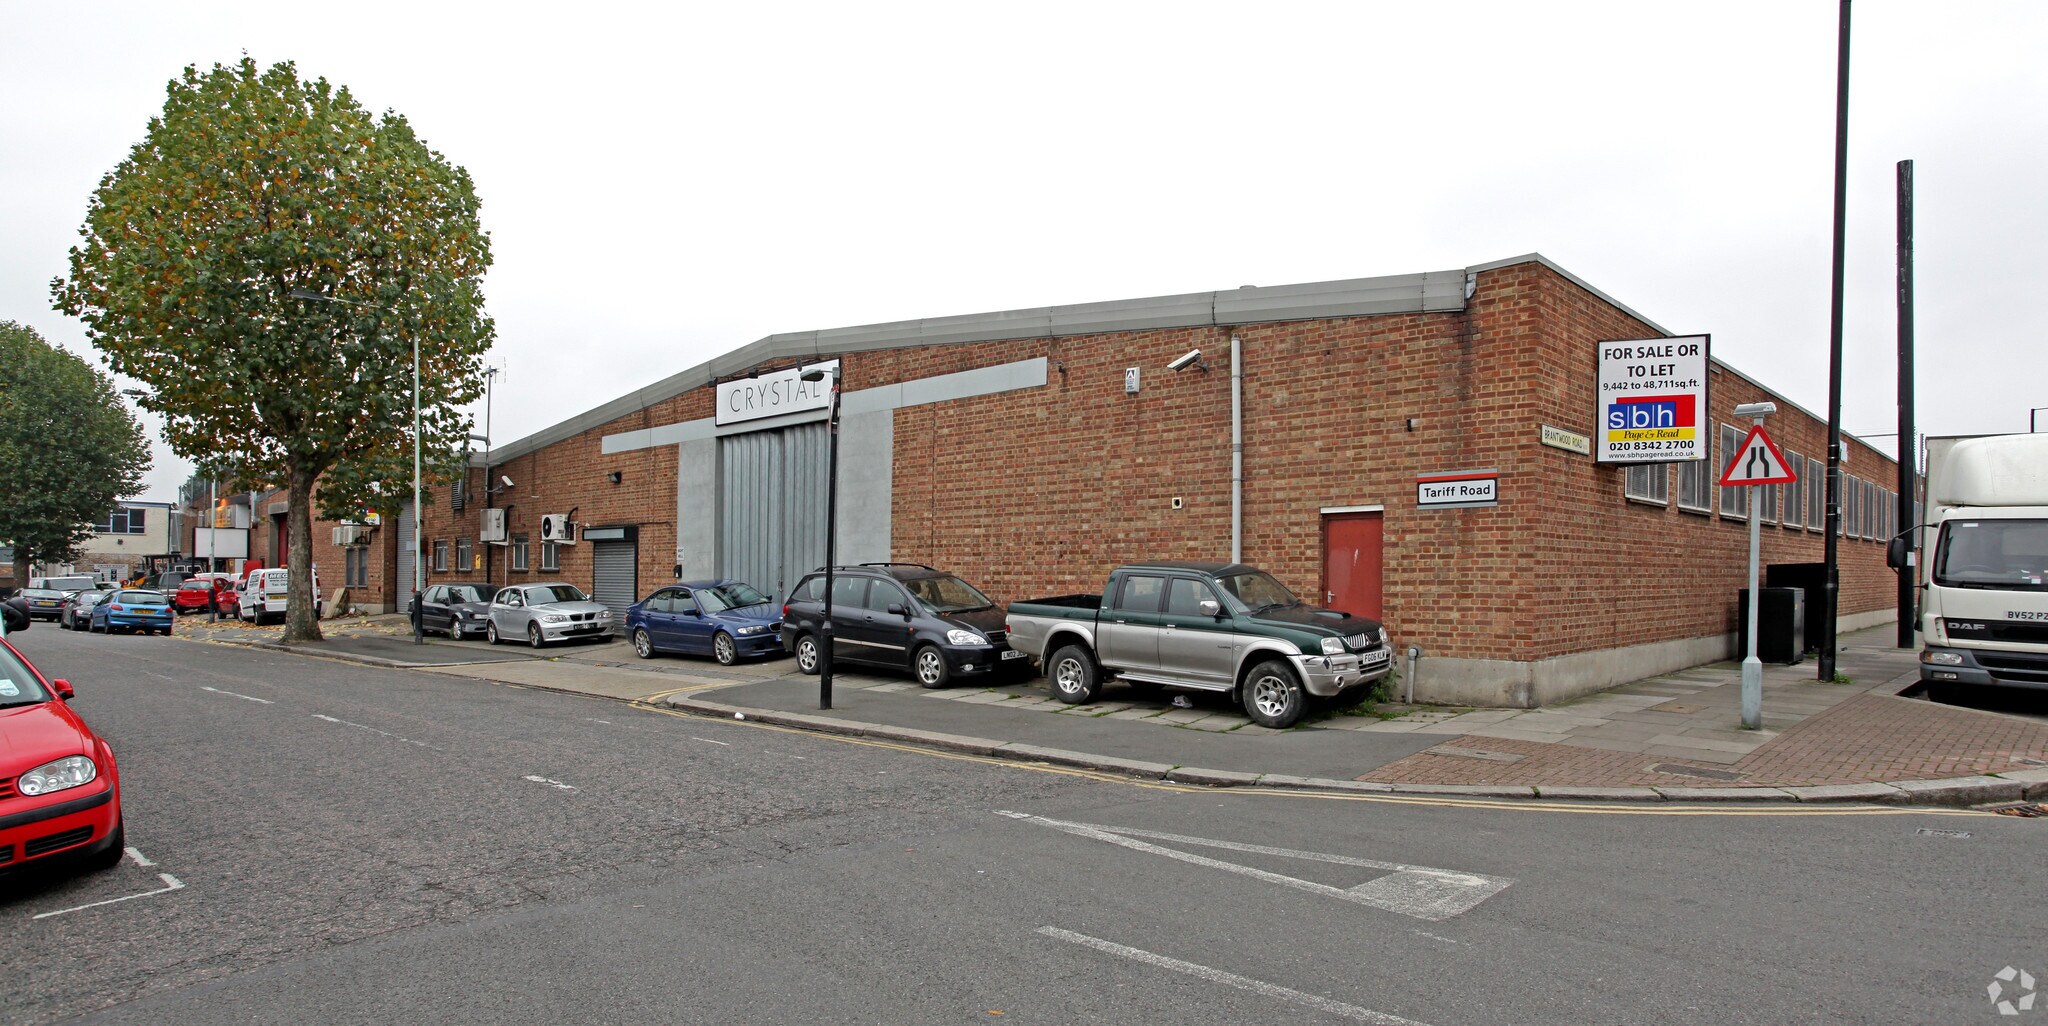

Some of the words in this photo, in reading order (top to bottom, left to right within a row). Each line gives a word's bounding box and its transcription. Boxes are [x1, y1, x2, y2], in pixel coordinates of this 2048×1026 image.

[1604, 347, 1633, 360] FOR
[1637, 345, 1673, 359] SALE
[1678, 344, 1699, 356] OR
[1627, 365, 1646, 377] TO
[1650, 364, 1676, 377] LET
[1603, 381, 1628, 391] 9,442
[1631, 381, 1640, 390] to
[730, 378, 821, 412] CRYSTAL
[1544, 429, 1571, 445] BRANTWOOD
[1572, 436, 1583, 449] ROAD
[1623, 430, 1643, 440] Page
[1645, 430, 1655, 439] &
[1656, 429, 1680, 438] Read
[1609, 442, 1631, 451] 020
[1634, 441, 1662, 450] 8342
[1665, 440, 1695, 449] 2700
[1608, 450, 1695, 459] www.sbhpageread.co.uk
[1424, 486, 1456, 498] Tariff
[1460, 484, 1491, 496] Road
[2007, 610, 2034, 620] BV52
[1947, 622, 1986, 630] DAF
